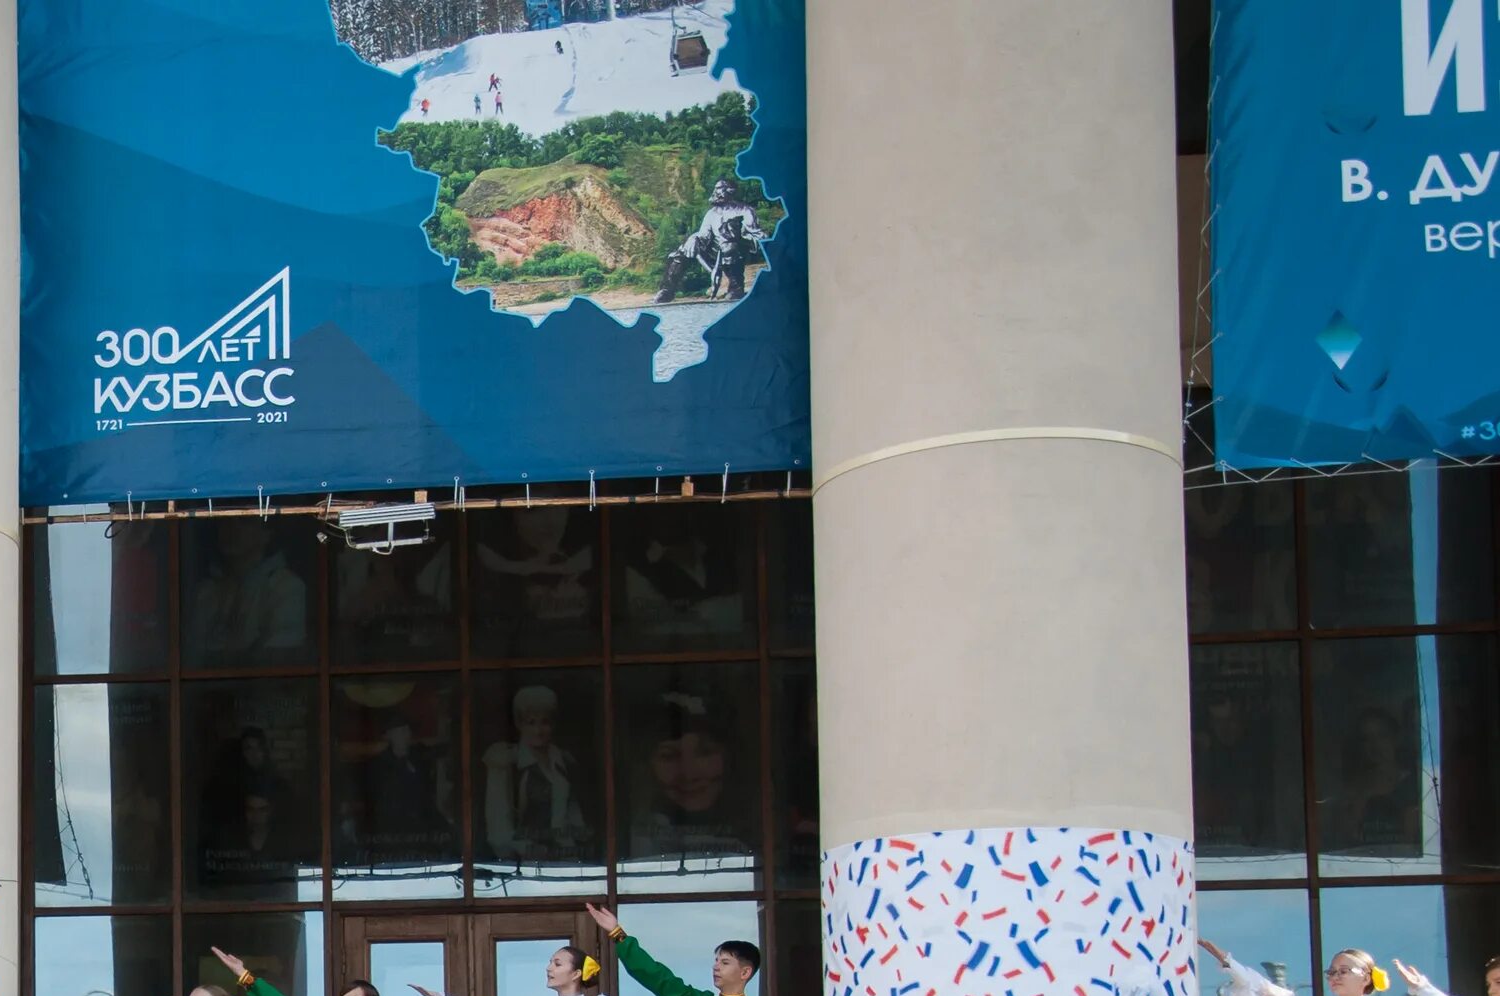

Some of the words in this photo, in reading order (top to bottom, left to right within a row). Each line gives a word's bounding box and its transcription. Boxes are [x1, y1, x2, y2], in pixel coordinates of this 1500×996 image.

[1341, 160, 1388, 201] В.
[1409, 151, 1500, 205] ДУ
[1424, 221, 1500, 259] вер
[94, 326, 180, 368] 300
[197, 337, 261, 363] ЛЕТ
[94, 367, 296, 414] КУЗБАСС
[95, 419, 123, 431] 1721
[257, 412, 288, 424] 2021
[1461, 421, 1500, 440] #3
